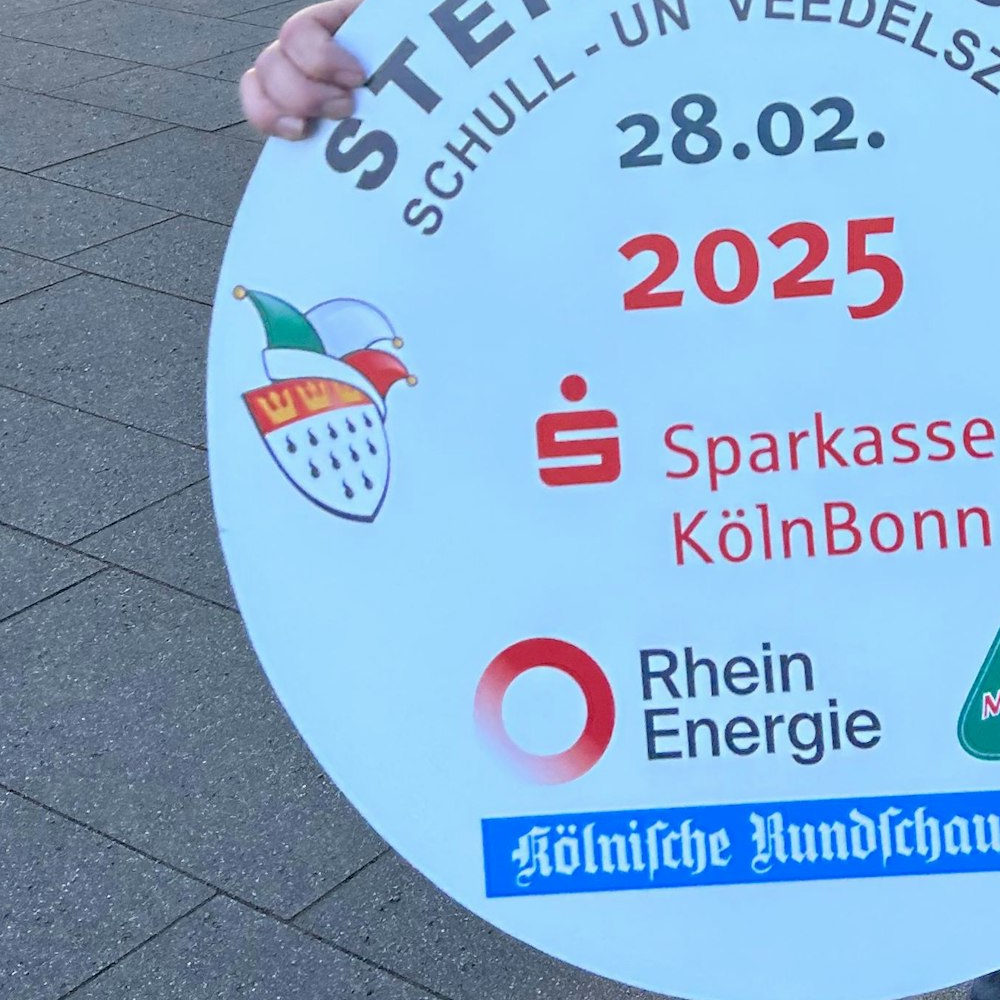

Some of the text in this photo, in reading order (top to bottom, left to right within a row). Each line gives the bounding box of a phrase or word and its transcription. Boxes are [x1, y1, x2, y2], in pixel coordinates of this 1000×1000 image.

[615, 93, 887, 169] 28.02.
[617, 216, 904, 320] 2025
[665, 412, 996, 491] Sparkasse
[673, 501, 993, 566] KölnBonn
[639, 642, 815, 702] Rhein
[643, 697, 882, 766] Energie
